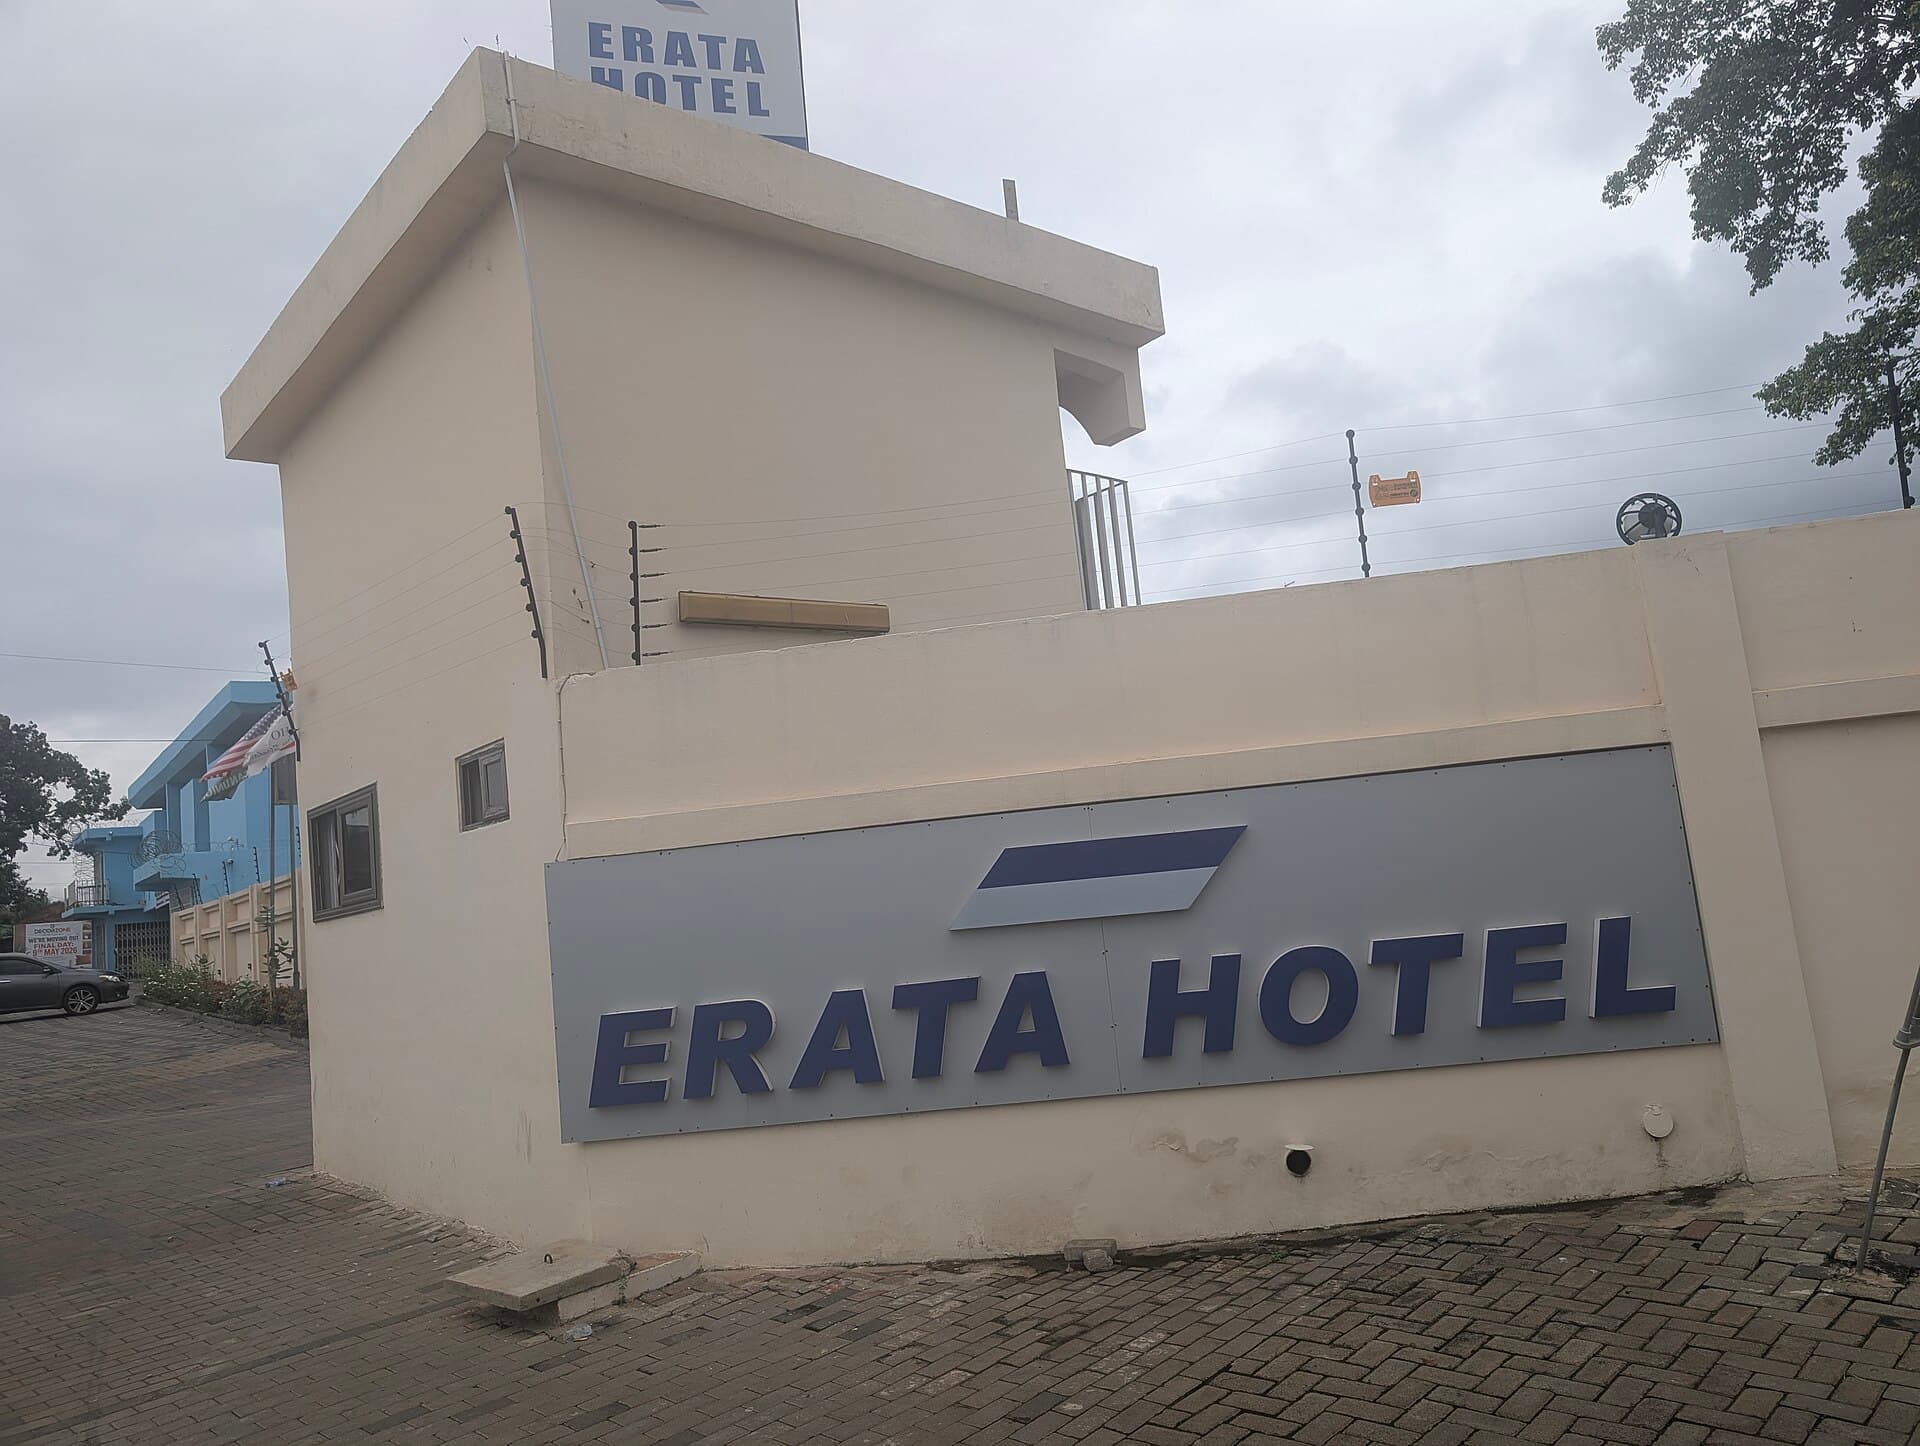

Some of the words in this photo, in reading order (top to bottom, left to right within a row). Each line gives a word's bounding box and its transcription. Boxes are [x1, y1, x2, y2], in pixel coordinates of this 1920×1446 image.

[588, 22, 765, 74] ERATA
[44, 948, 59, 956] MAY
[589, 970, 1070, 1108] ERATA
[1143, 917, 1676, 1059] HOTEL
